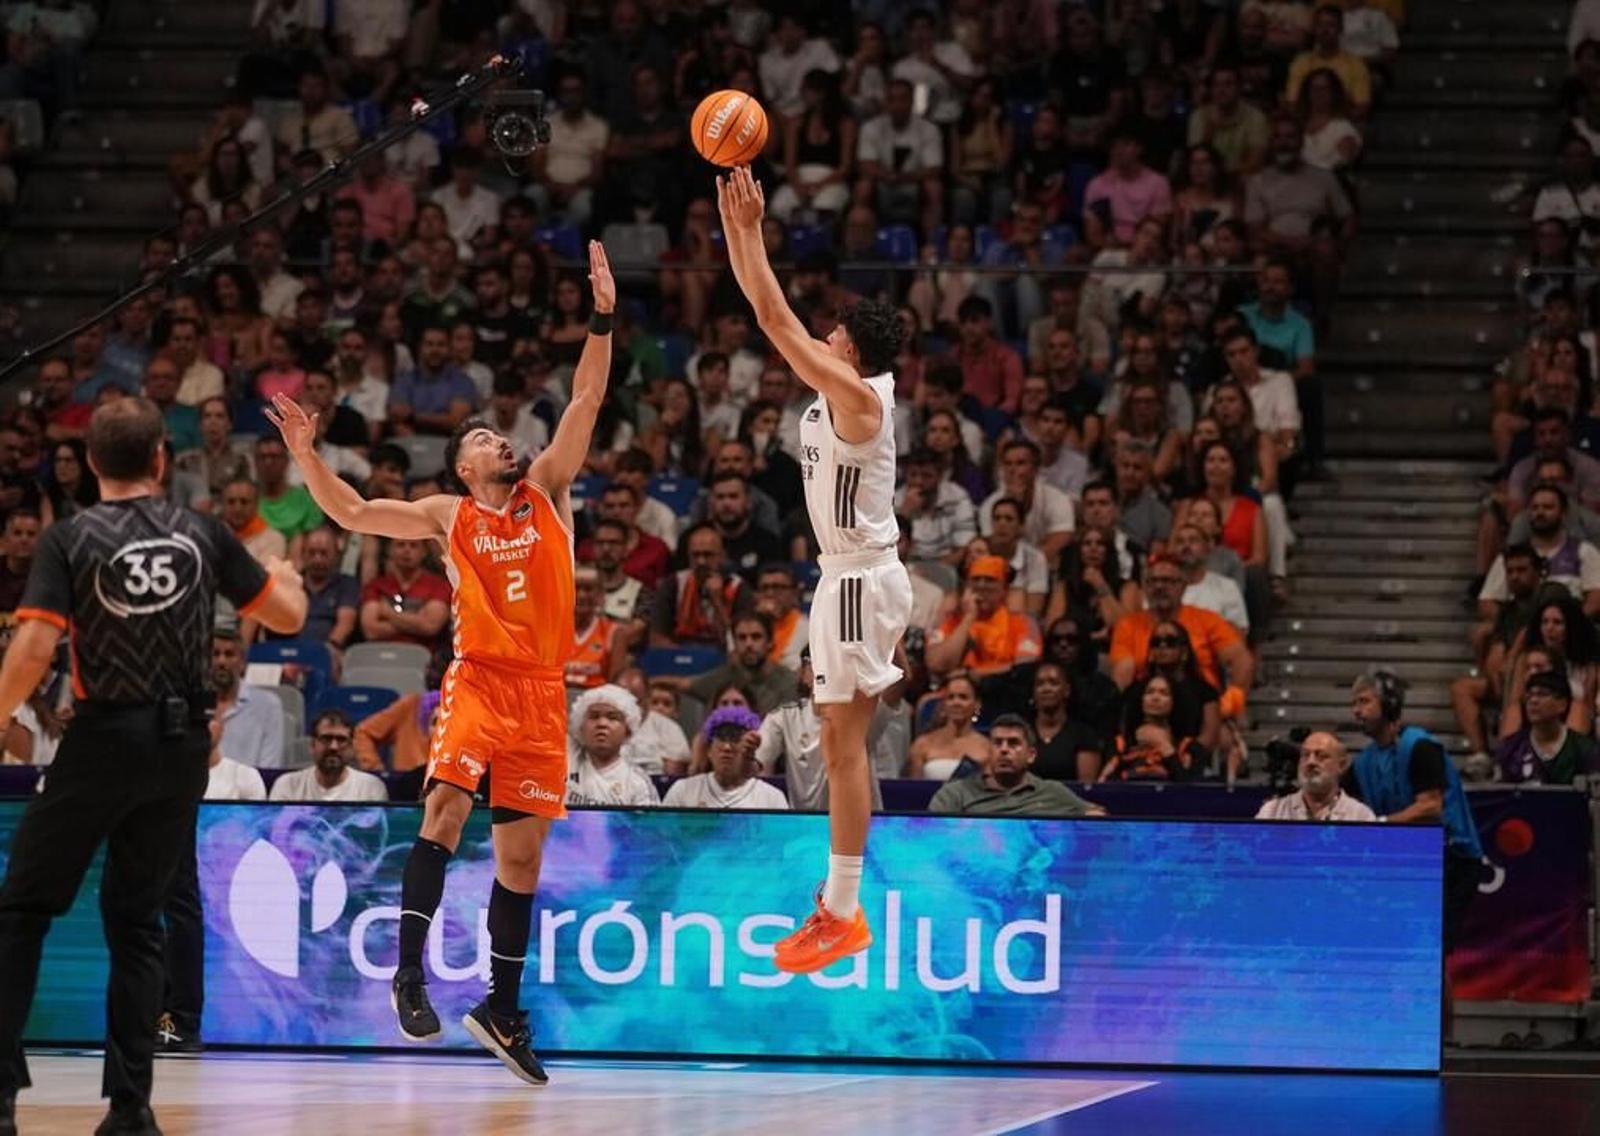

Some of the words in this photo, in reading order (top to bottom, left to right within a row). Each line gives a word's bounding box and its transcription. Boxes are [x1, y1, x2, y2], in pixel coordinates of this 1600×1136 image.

[706, 97, 742, 140] Wilson
[473, 525, 542, 555] VALENCA
[491, 548, 531, 563] BASKET
[123, 554, 178, 596] 35
[506, 570, 527, 602] 2
